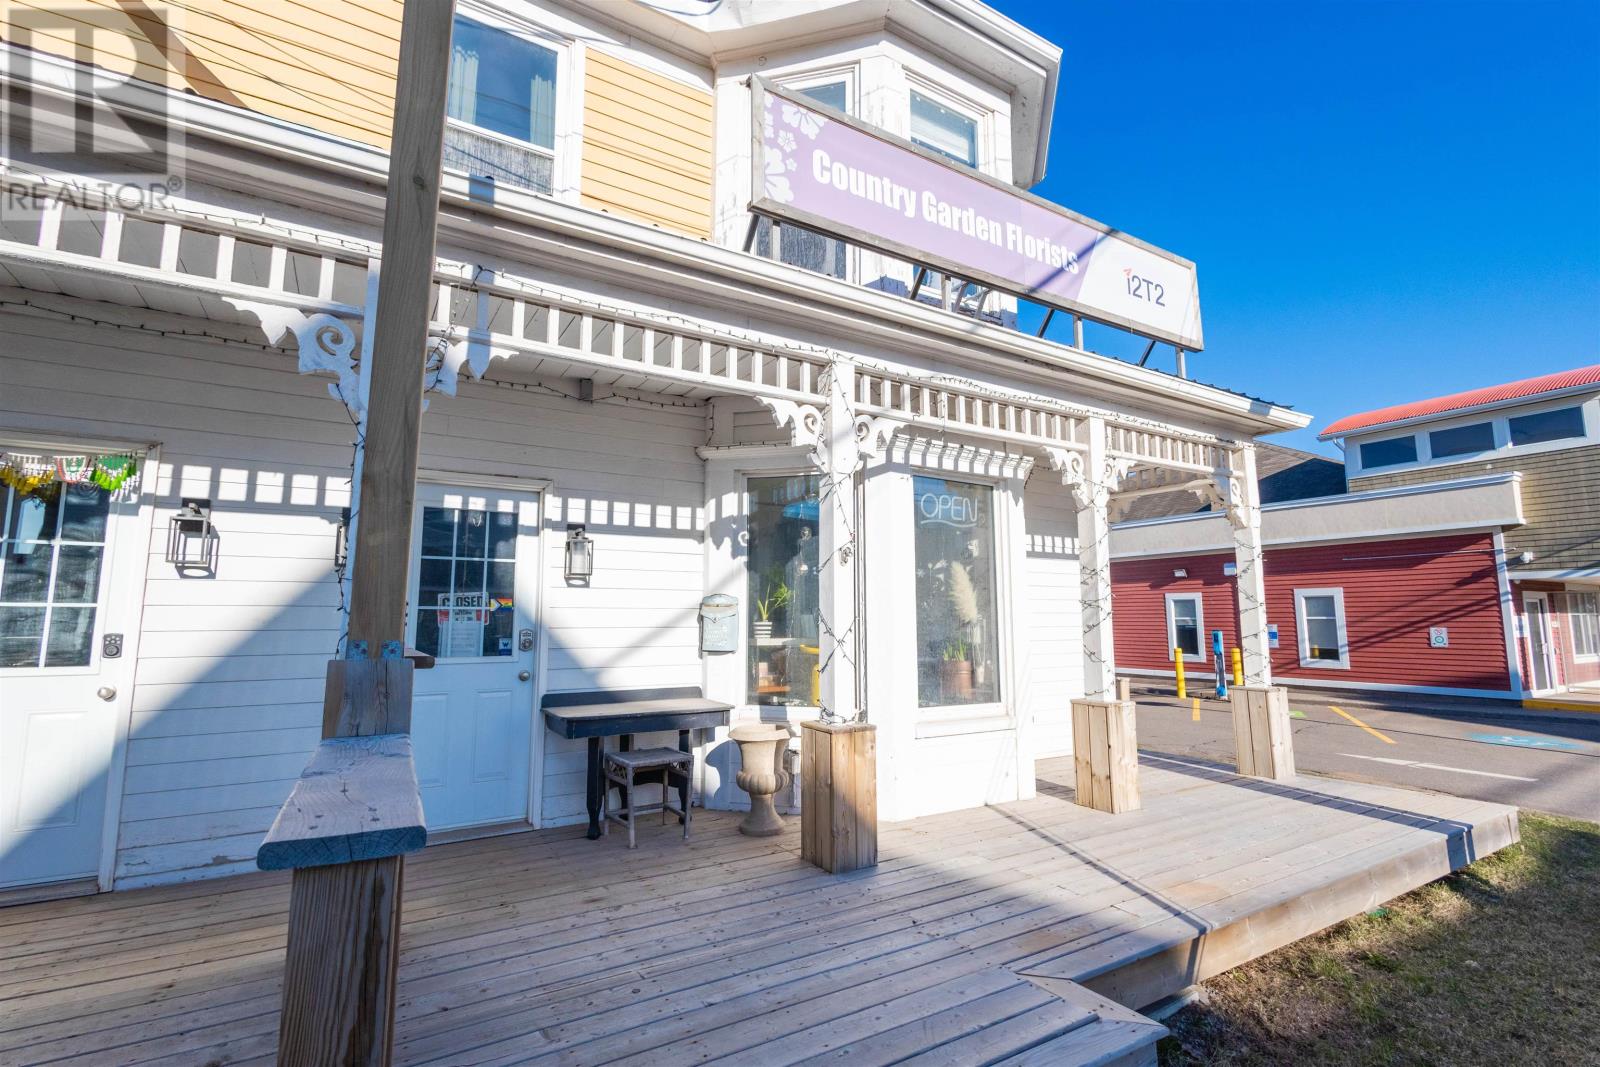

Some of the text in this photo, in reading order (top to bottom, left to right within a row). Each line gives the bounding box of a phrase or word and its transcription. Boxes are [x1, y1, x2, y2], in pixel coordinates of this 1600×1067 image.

[812, 149, 1079, 275] Country Garden Florists
[920, 493, 978, 522] OPEN
[442, 596, 487, 608] COSED
